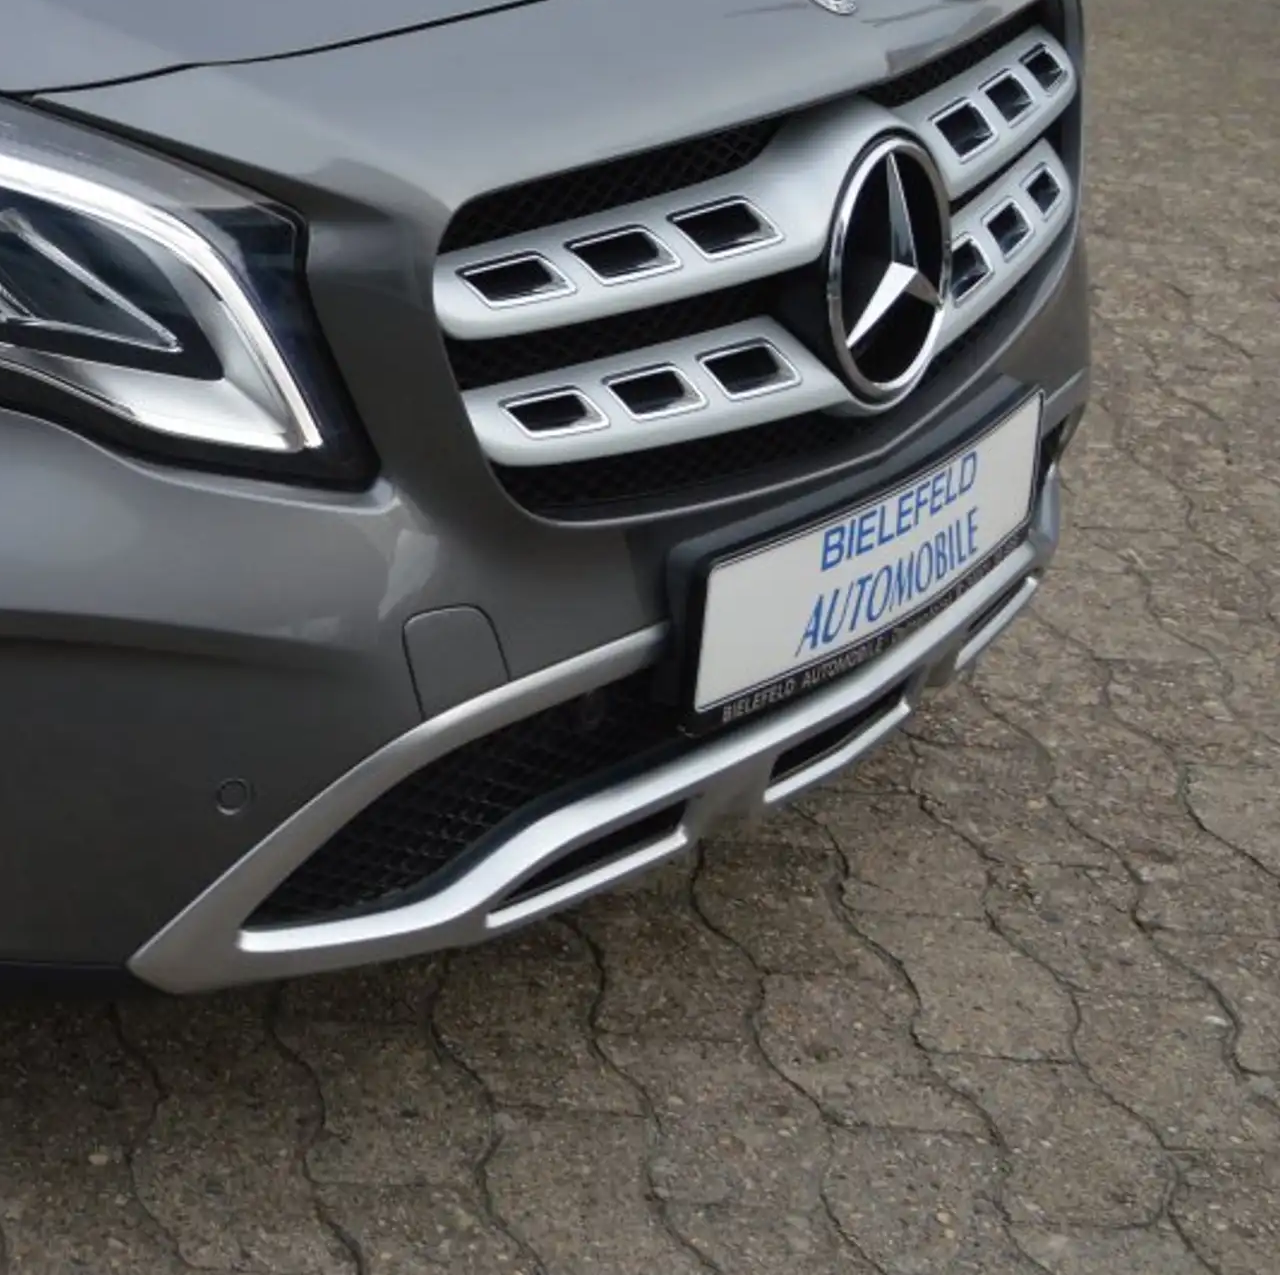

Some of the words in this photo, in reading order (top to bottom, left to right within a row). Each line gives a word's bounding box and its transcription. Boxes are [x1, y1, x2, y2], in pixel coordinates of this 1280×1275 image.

[821, 452, 978, 572] BIELEFELD
[795, 507, 979, 657] AUTOMOBILE
[722, 680, 795, 723] BIELEFELD
[801, 636, 885, 689] AUTOMOBILE
